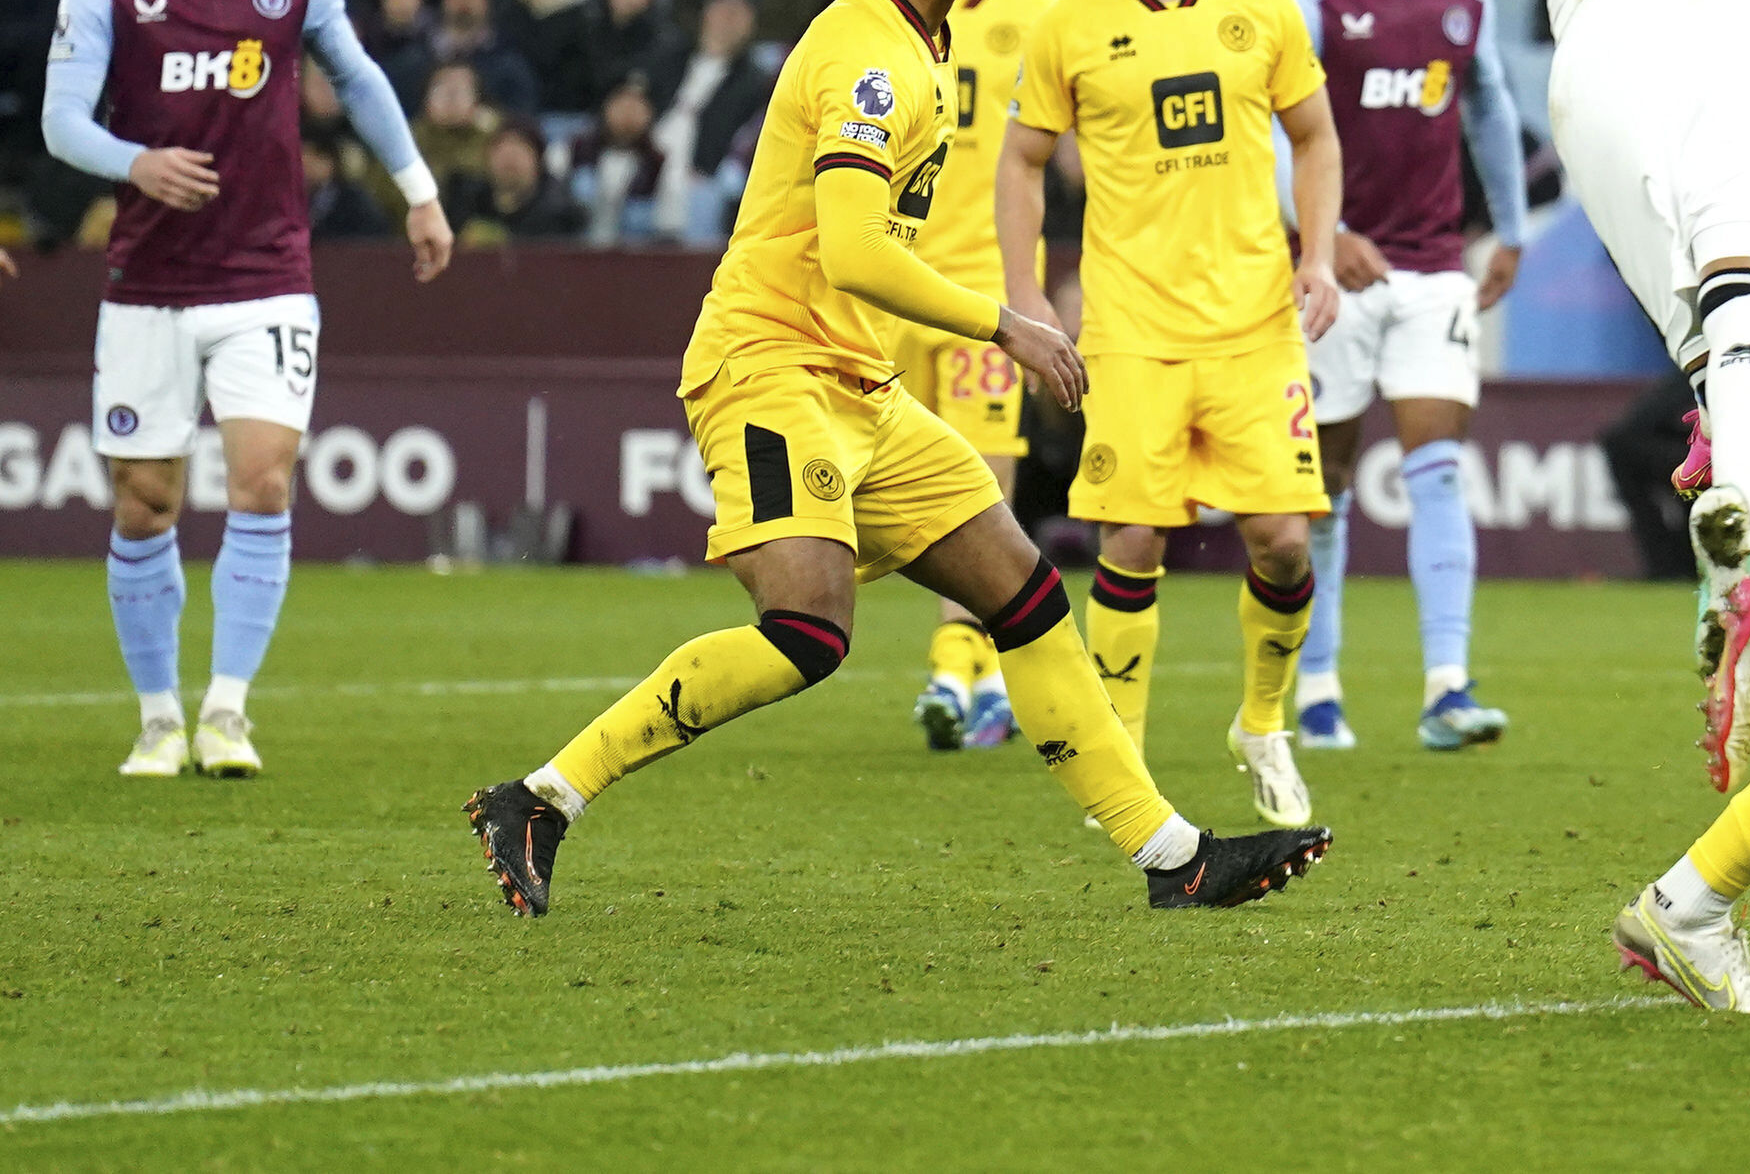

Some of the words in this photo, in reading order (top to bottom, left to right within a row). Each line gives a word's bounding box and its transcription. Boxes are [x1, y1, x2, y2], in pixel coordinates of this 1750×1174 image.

[160, 39, 272, 99] BK8
[1360, 59, 1456, 118] BK8
[1162, 90, 1218, 131] CFI
[266, 325, 313, 378] 15
[951, 347, 1012, 399] 28
[1286, 383, 1313, 438] 2
